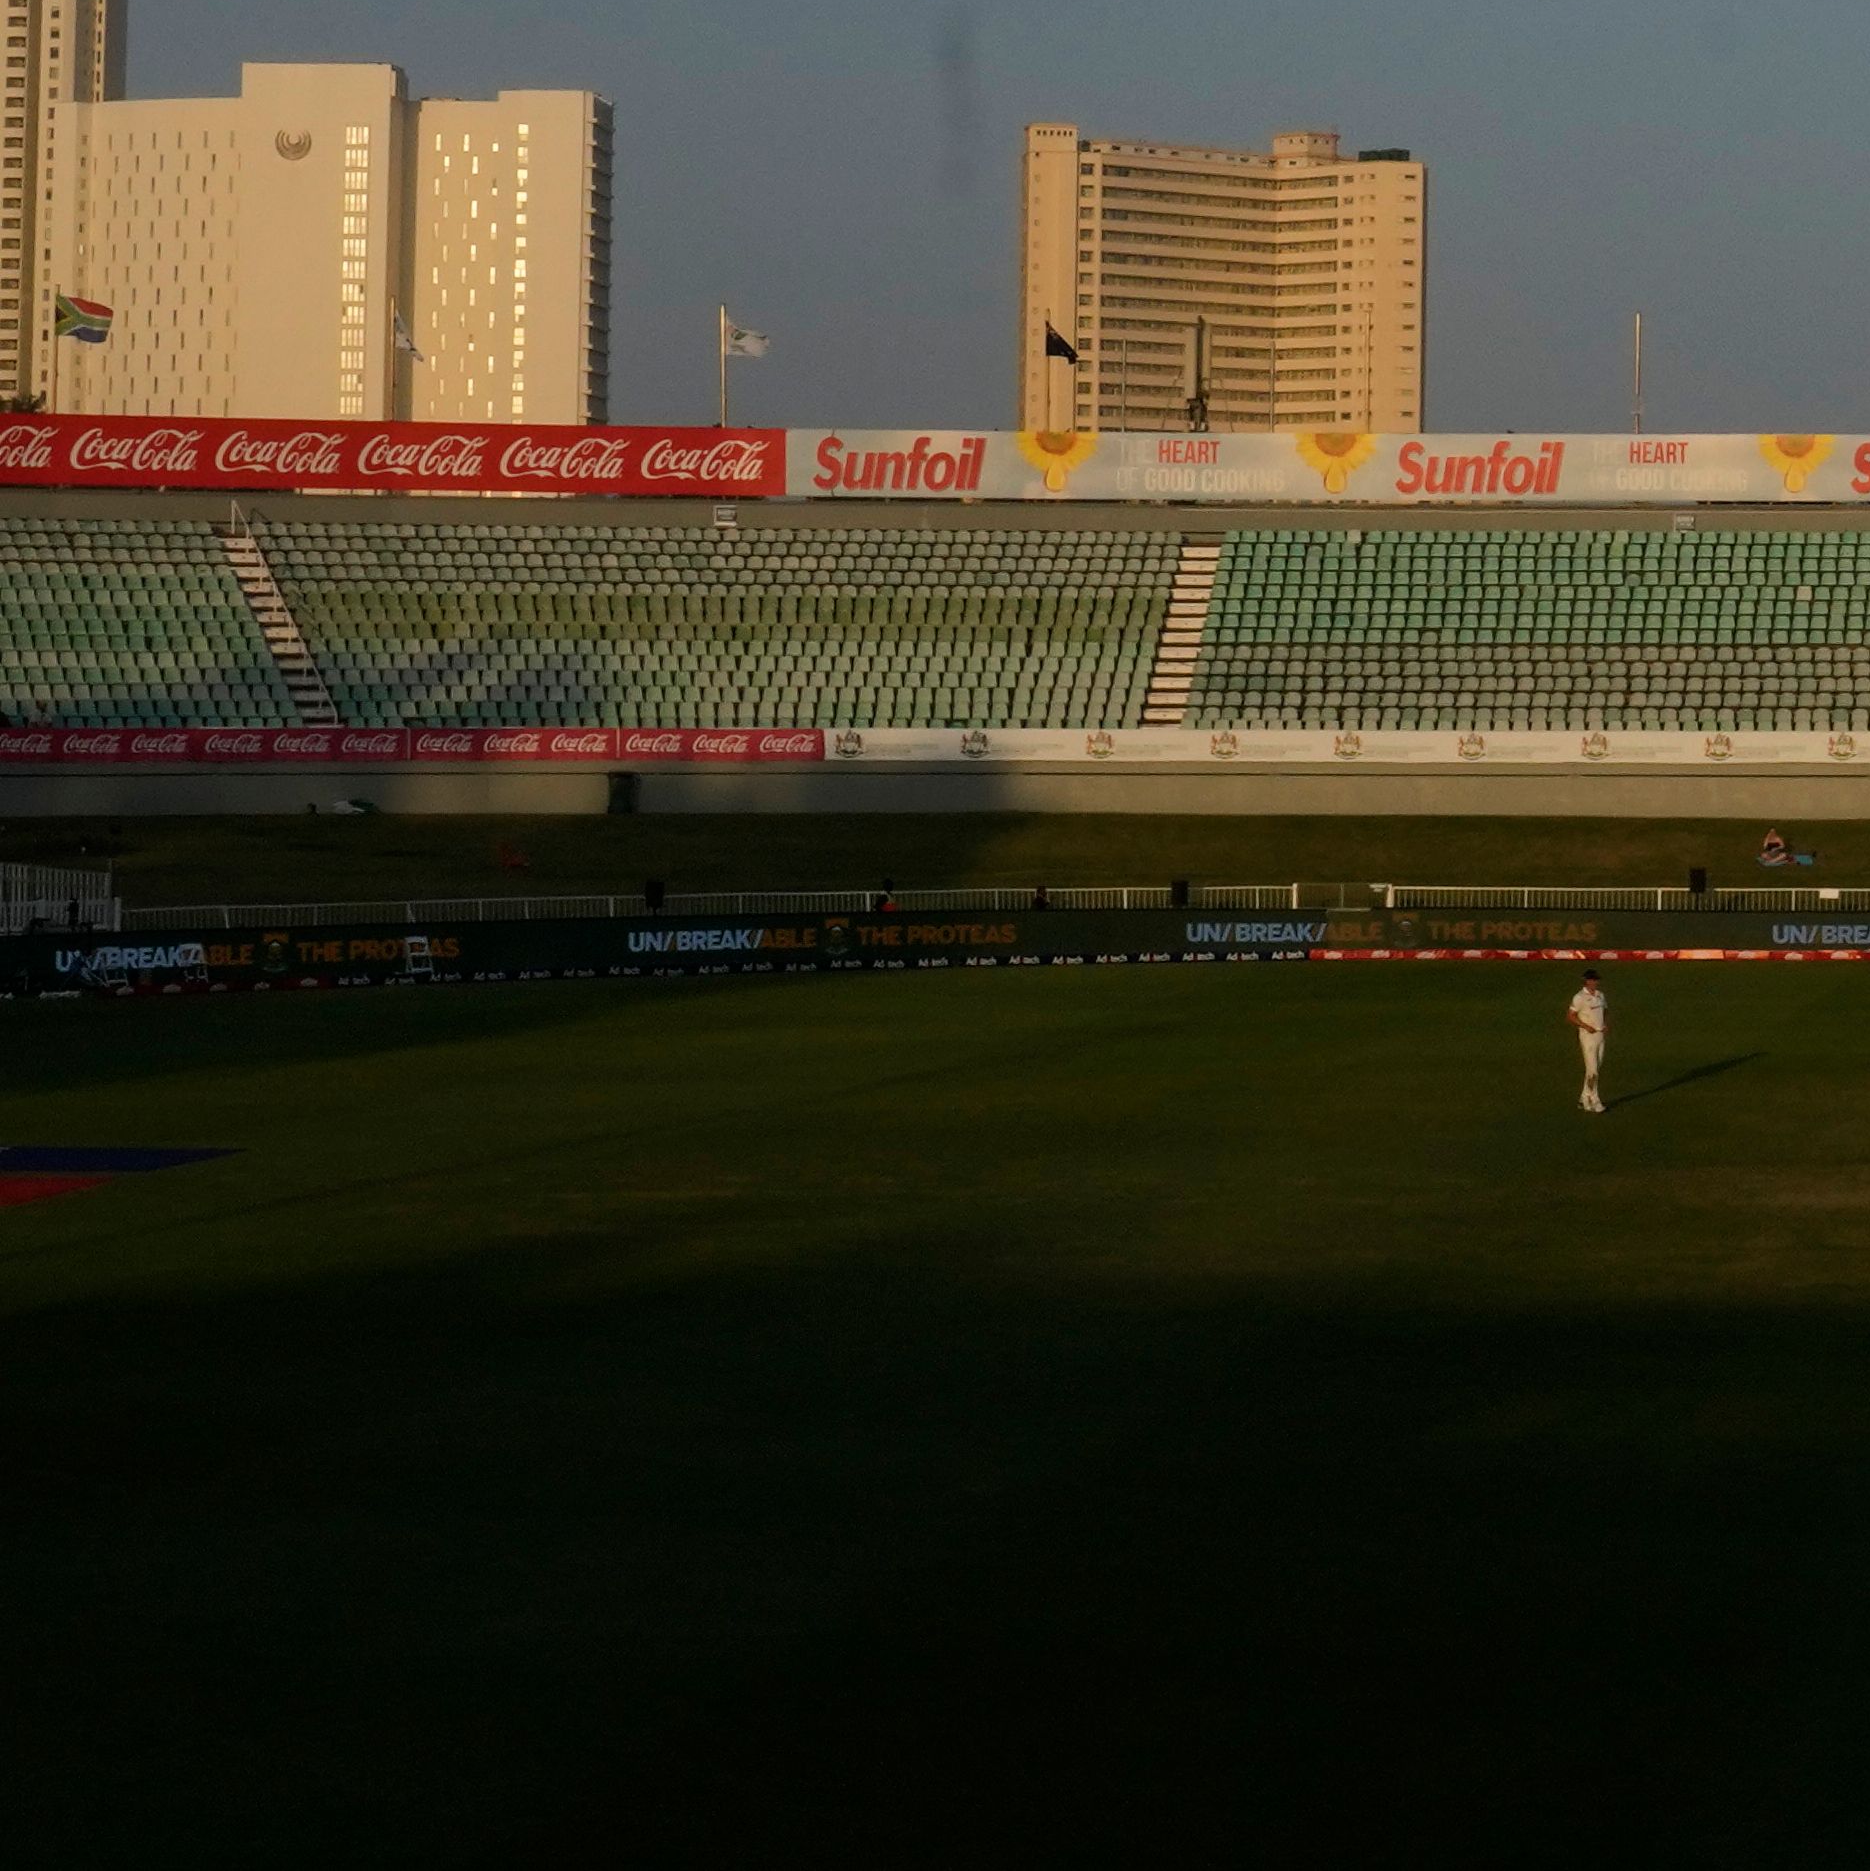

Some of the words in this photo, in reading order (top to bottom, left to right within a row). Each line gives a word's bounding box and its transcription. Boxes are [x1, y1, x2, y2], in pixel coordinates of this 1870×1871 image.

[70, 428, 201, 471] Coca-Cola
[215, 431, 348, 474] Coca-Cola
[358, 433, 491, 477] Coca-Cola
[501, 436, 630, 479] Coca-Cola
[641, 439, 771, 481] Coca-Cola
[813, 436, 987, 491] Sunfoil
[1158, 440, 1220, 464] HEART
[1396, 441, 1566, 494] Sunfoil
[1630, 442, 1689, 464] HEART
[626, 733, 682, 754] Coca-Cola
[693, 733, 749, 754] Coca-Cola
[760, 733, 817, 754] Coca-Cola
